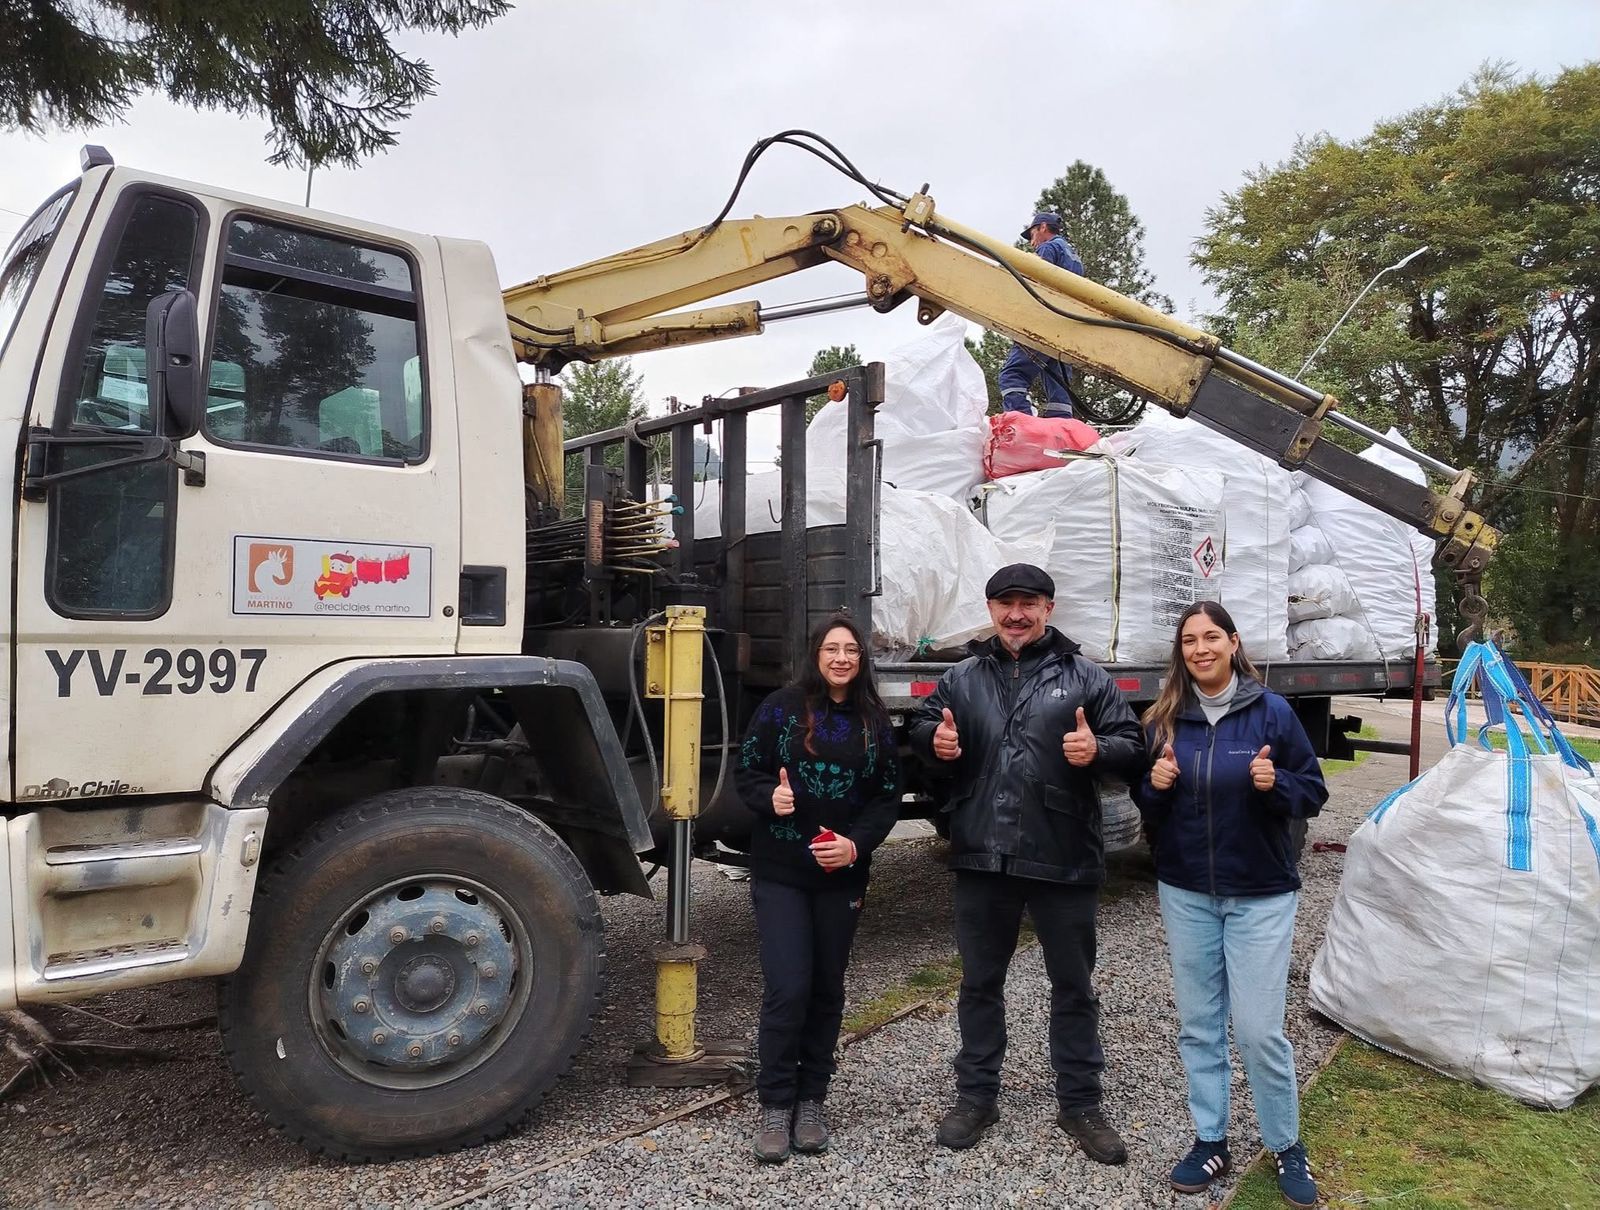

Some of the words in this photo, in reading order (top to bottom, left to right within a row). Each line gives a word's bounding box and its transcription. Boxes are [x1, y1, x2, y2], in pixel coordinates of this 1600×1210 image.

[247, 600, 293, 609] MARTINO
[314, 601, 410, 613] @reciclajes_martino
[45, 648, 267, 697] YV-2997
[80, 780, 130, 797] Chile
